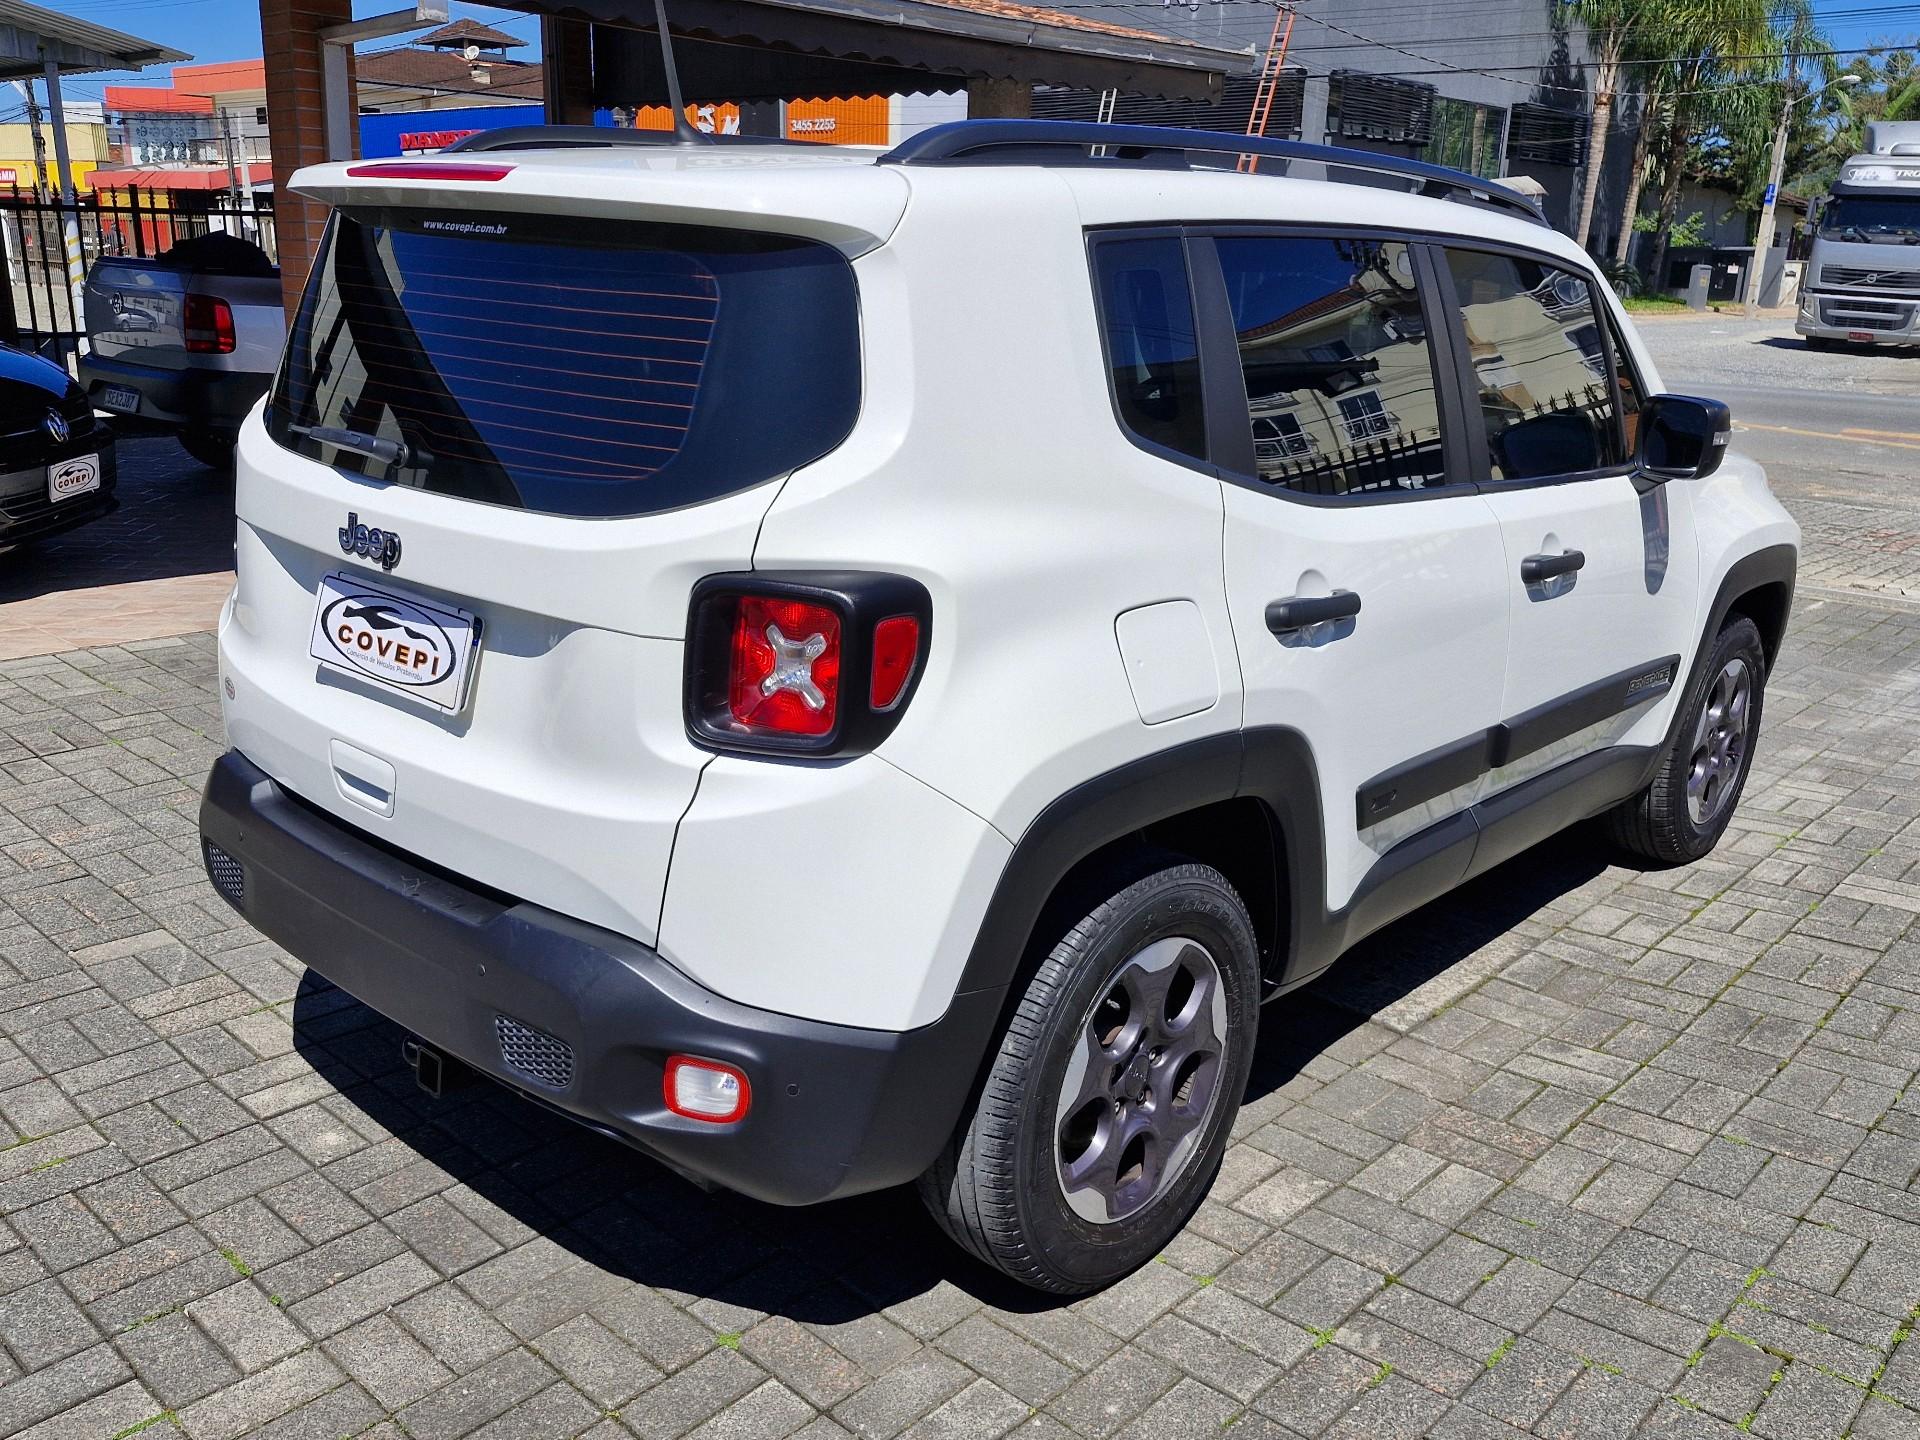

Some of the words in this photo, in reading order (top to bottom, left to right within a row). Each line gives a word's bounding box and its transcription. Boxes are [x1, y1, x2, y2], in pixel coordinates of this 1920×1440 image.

[423, 220, 508, 234] www.covepi.com.br
[58, 473, 90, 489] COVEPI
[338, 511, 402, 570] Jeep
[338, 624, 440, 676] COVEPI
